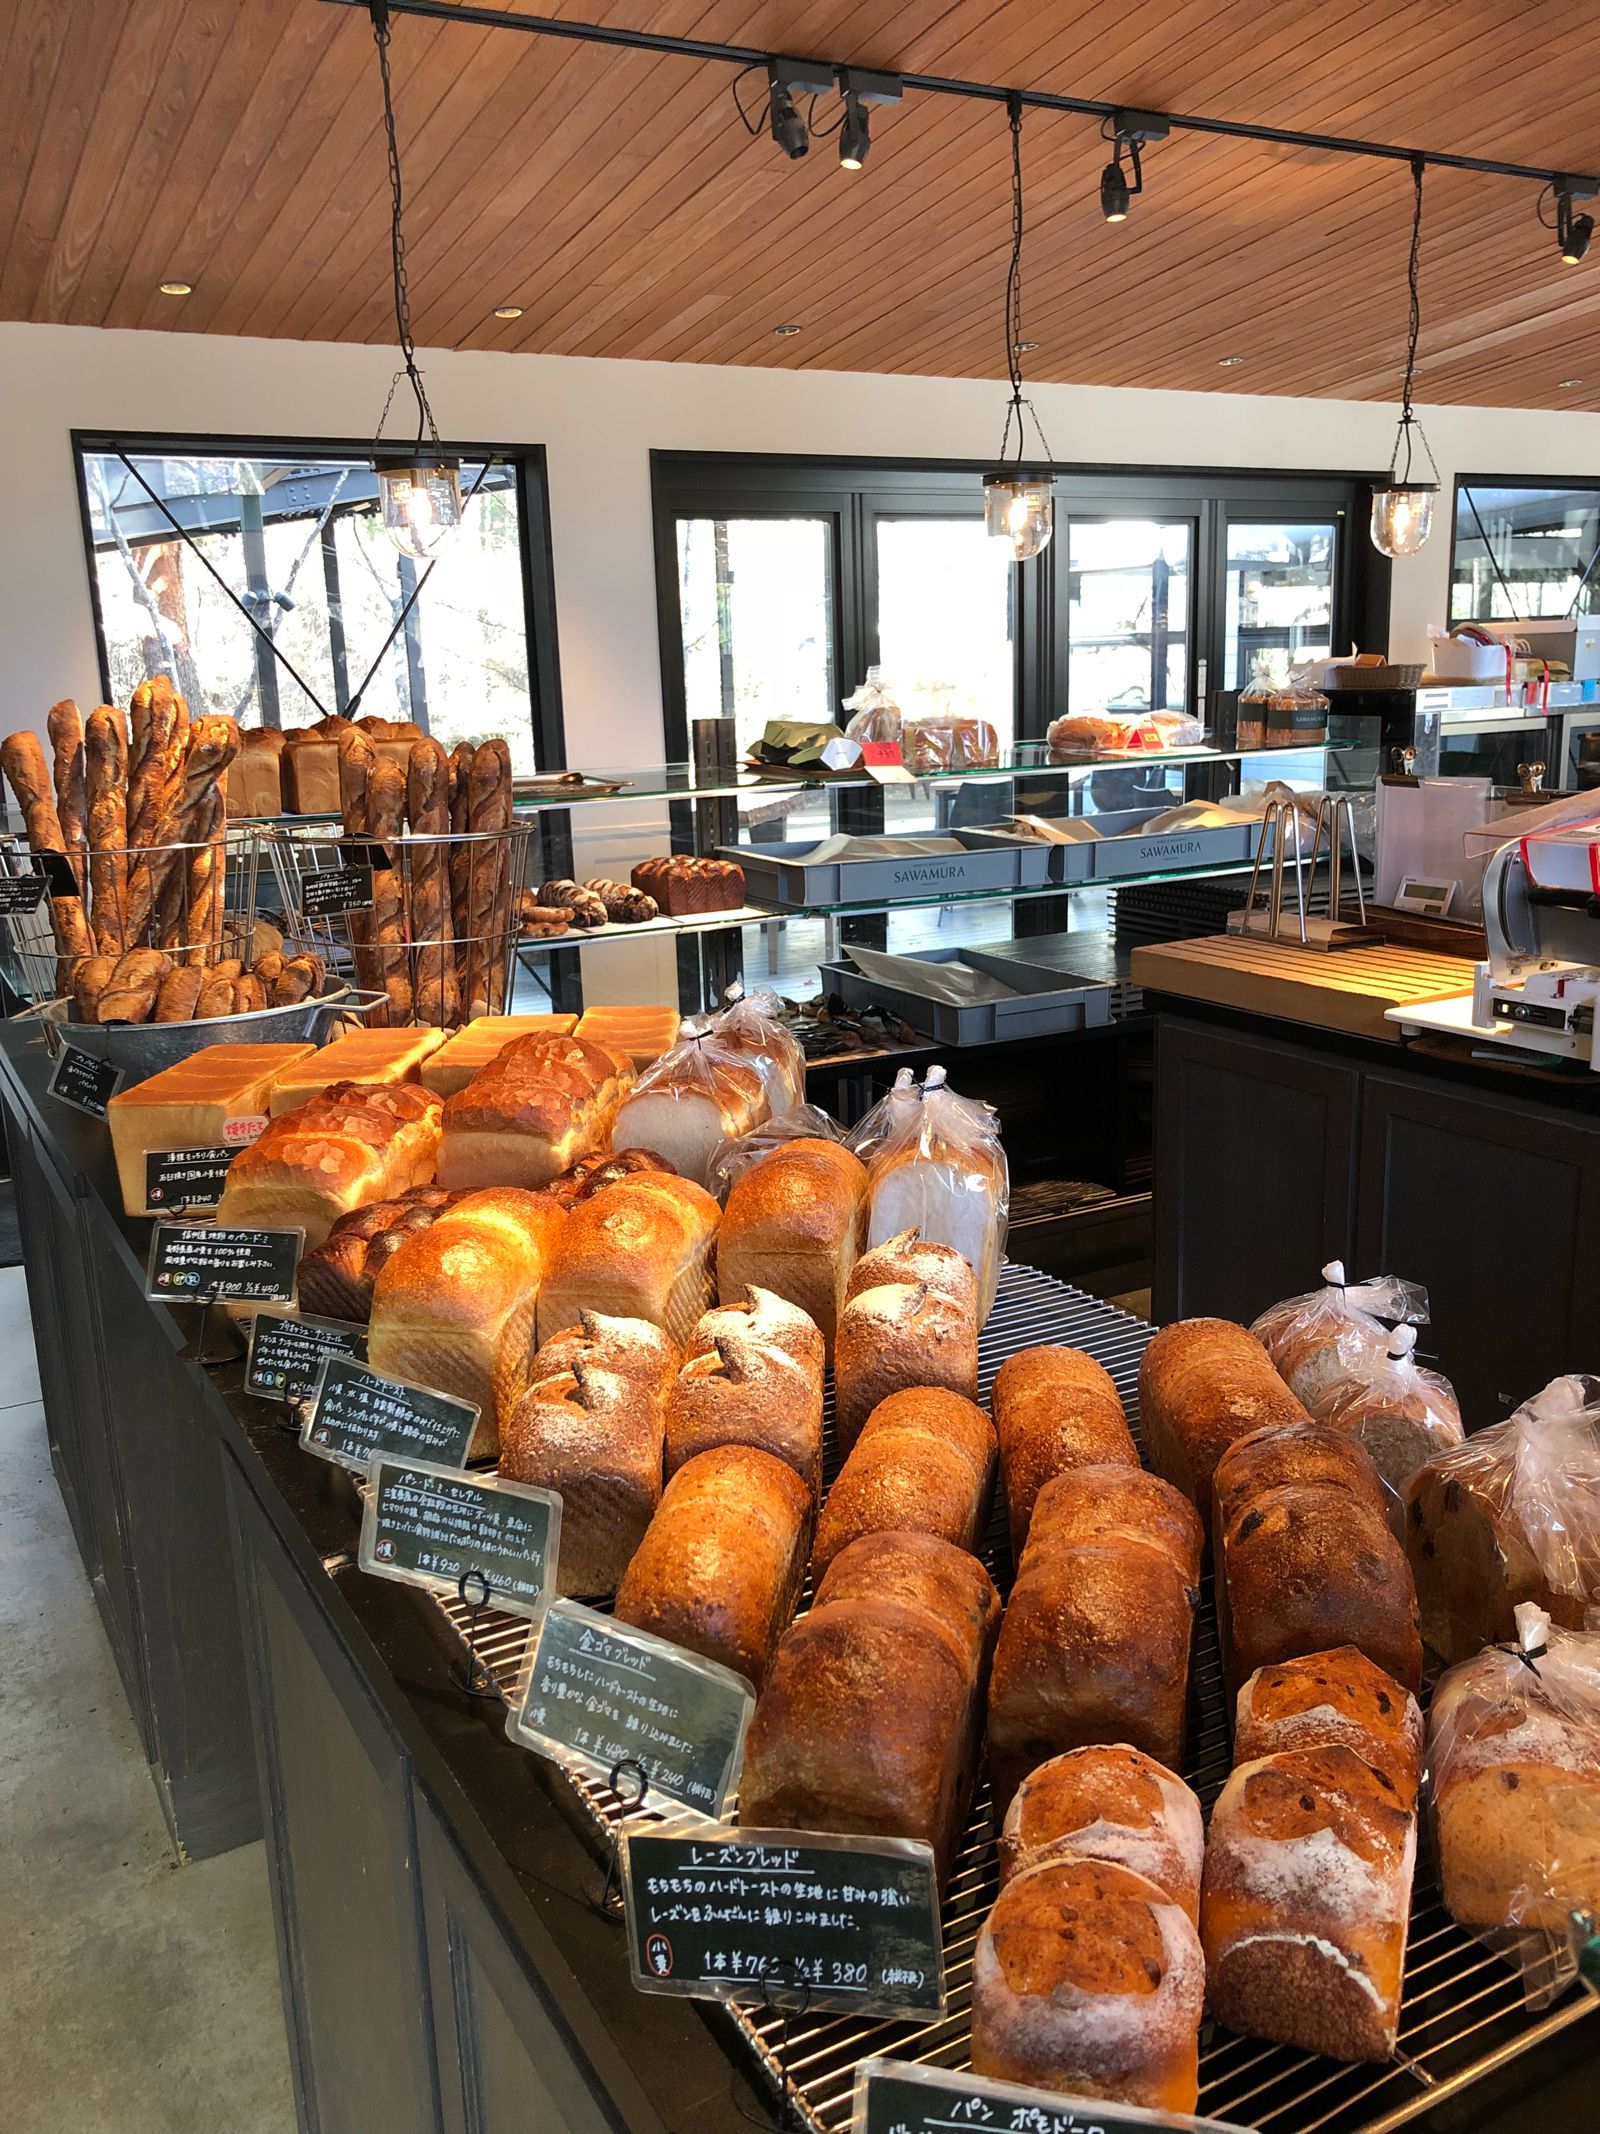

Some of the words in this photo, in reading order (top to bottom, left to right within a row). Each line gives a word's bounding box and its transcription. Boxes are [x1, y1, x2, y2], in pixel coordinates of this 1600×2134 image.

[1140, 841, 1201, 858] SAWAMURA
[894, 866, 965, 883] SAWAMURA
[225, 1121, 264, 1135] 焼きたて
[359, 1375, 406, 1398] ハードトースト
[579, 1629, 652, 1670] 金ゴマブレッド
[547, 1655, 680, 1719] もちもちしたハードトーストの生地に
[692, 1845, 799, 1869] レーズンブレッド
[647, 1877, 909, 1907] もちもちのハードトーストの生地に甘みの強い
[651, 1941, 667, 1975] 小麦
[951, 2097, 994, 2121] パン
